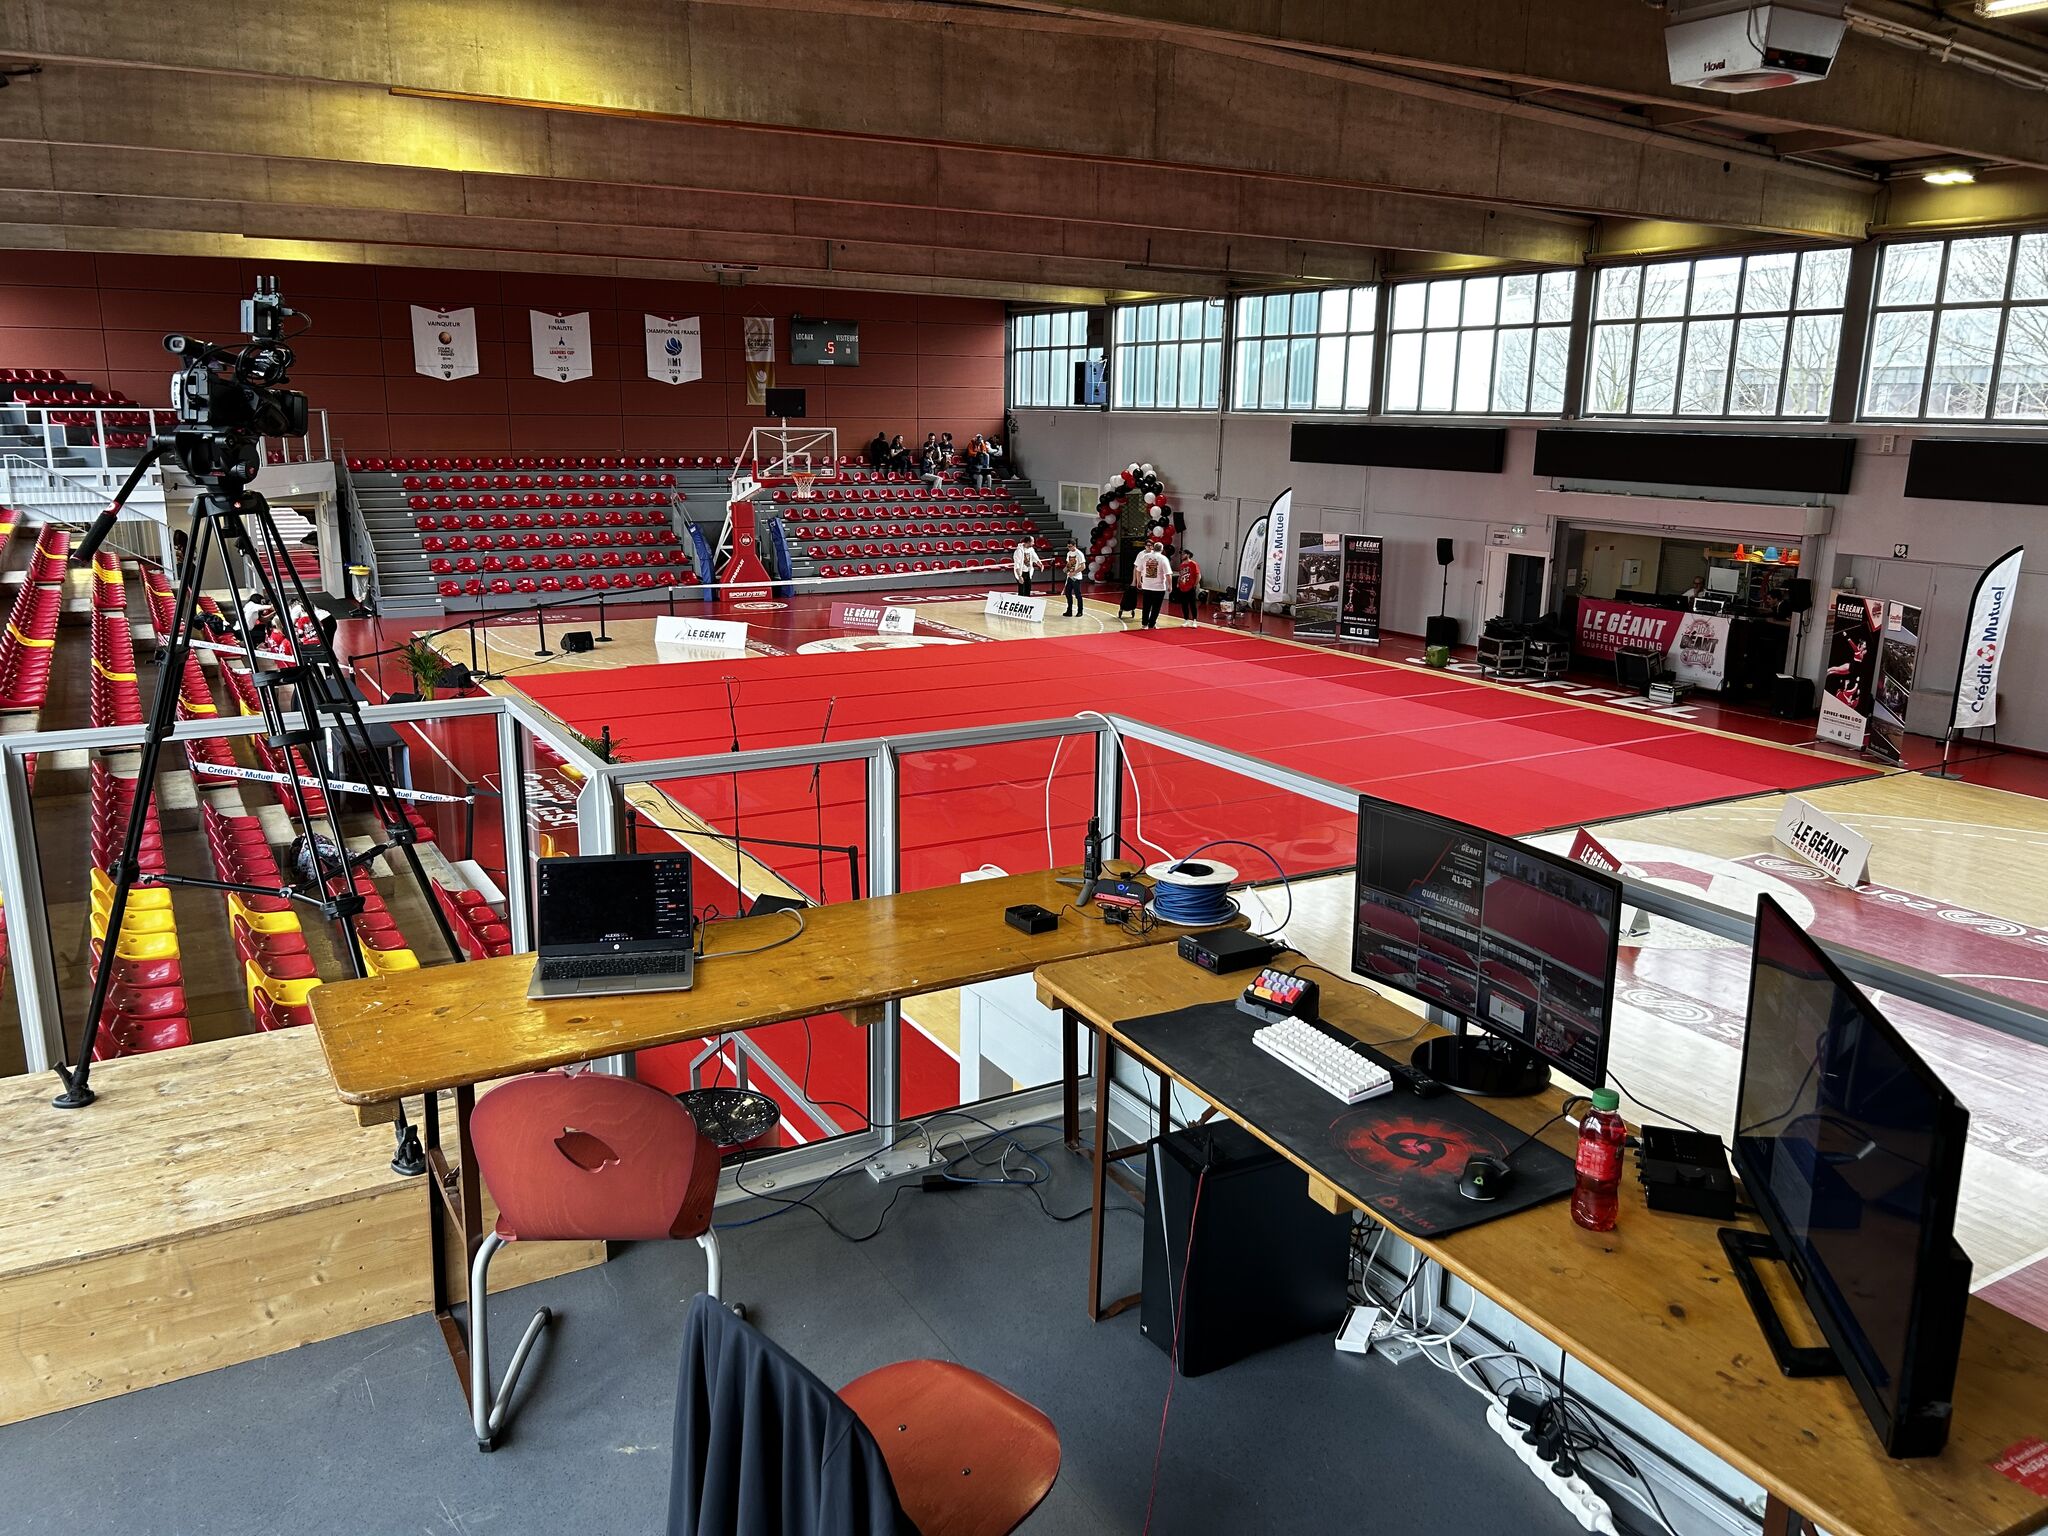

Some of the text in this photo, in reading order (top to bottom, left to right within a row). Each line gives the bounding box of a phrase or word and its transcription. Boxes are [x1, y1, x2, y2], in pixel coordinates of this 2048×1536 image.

[1703, 59, 1726, 73] Hoval
[427, 320, 461, 328] VAINQUEUR
[795, 333, 859, 342] LOCAUX VISITEURS
[1271, 513, 1285, 593] Crédit Mutuel
[843, 606, 881, 619] LE GÉANT
[999, 600, 1035, 615] LE GÉANT
[1837, 602, 1865, 615] LE GÉANT
[1582, 609, 1667, 640] LE GÉANT
[687, 629, 698, 638] LE
[698, 628, 726, 640] GÉANT
[1582, 629, 1663, 651] CHEERLEADING
[1680, 631, 1719, 654] GÉANT
[1971, 585, 2006, 713] Crédit Mutuel
[207, 765, 274, 781] Crédit Mutuel
[419, 793, 443, 801] Crédit
[1460, 842, 1483, 857] GÉANT
[1793, 820, 1850, 866] LE GÉANT
[1580, 843, 1594, 864] LE
[1790, 836, 1842, 876] CHEERLEADING
[1451, 874, 1473, 889] 41:42
[1421, 888, 1480, 916] QUALIFICATIONS
